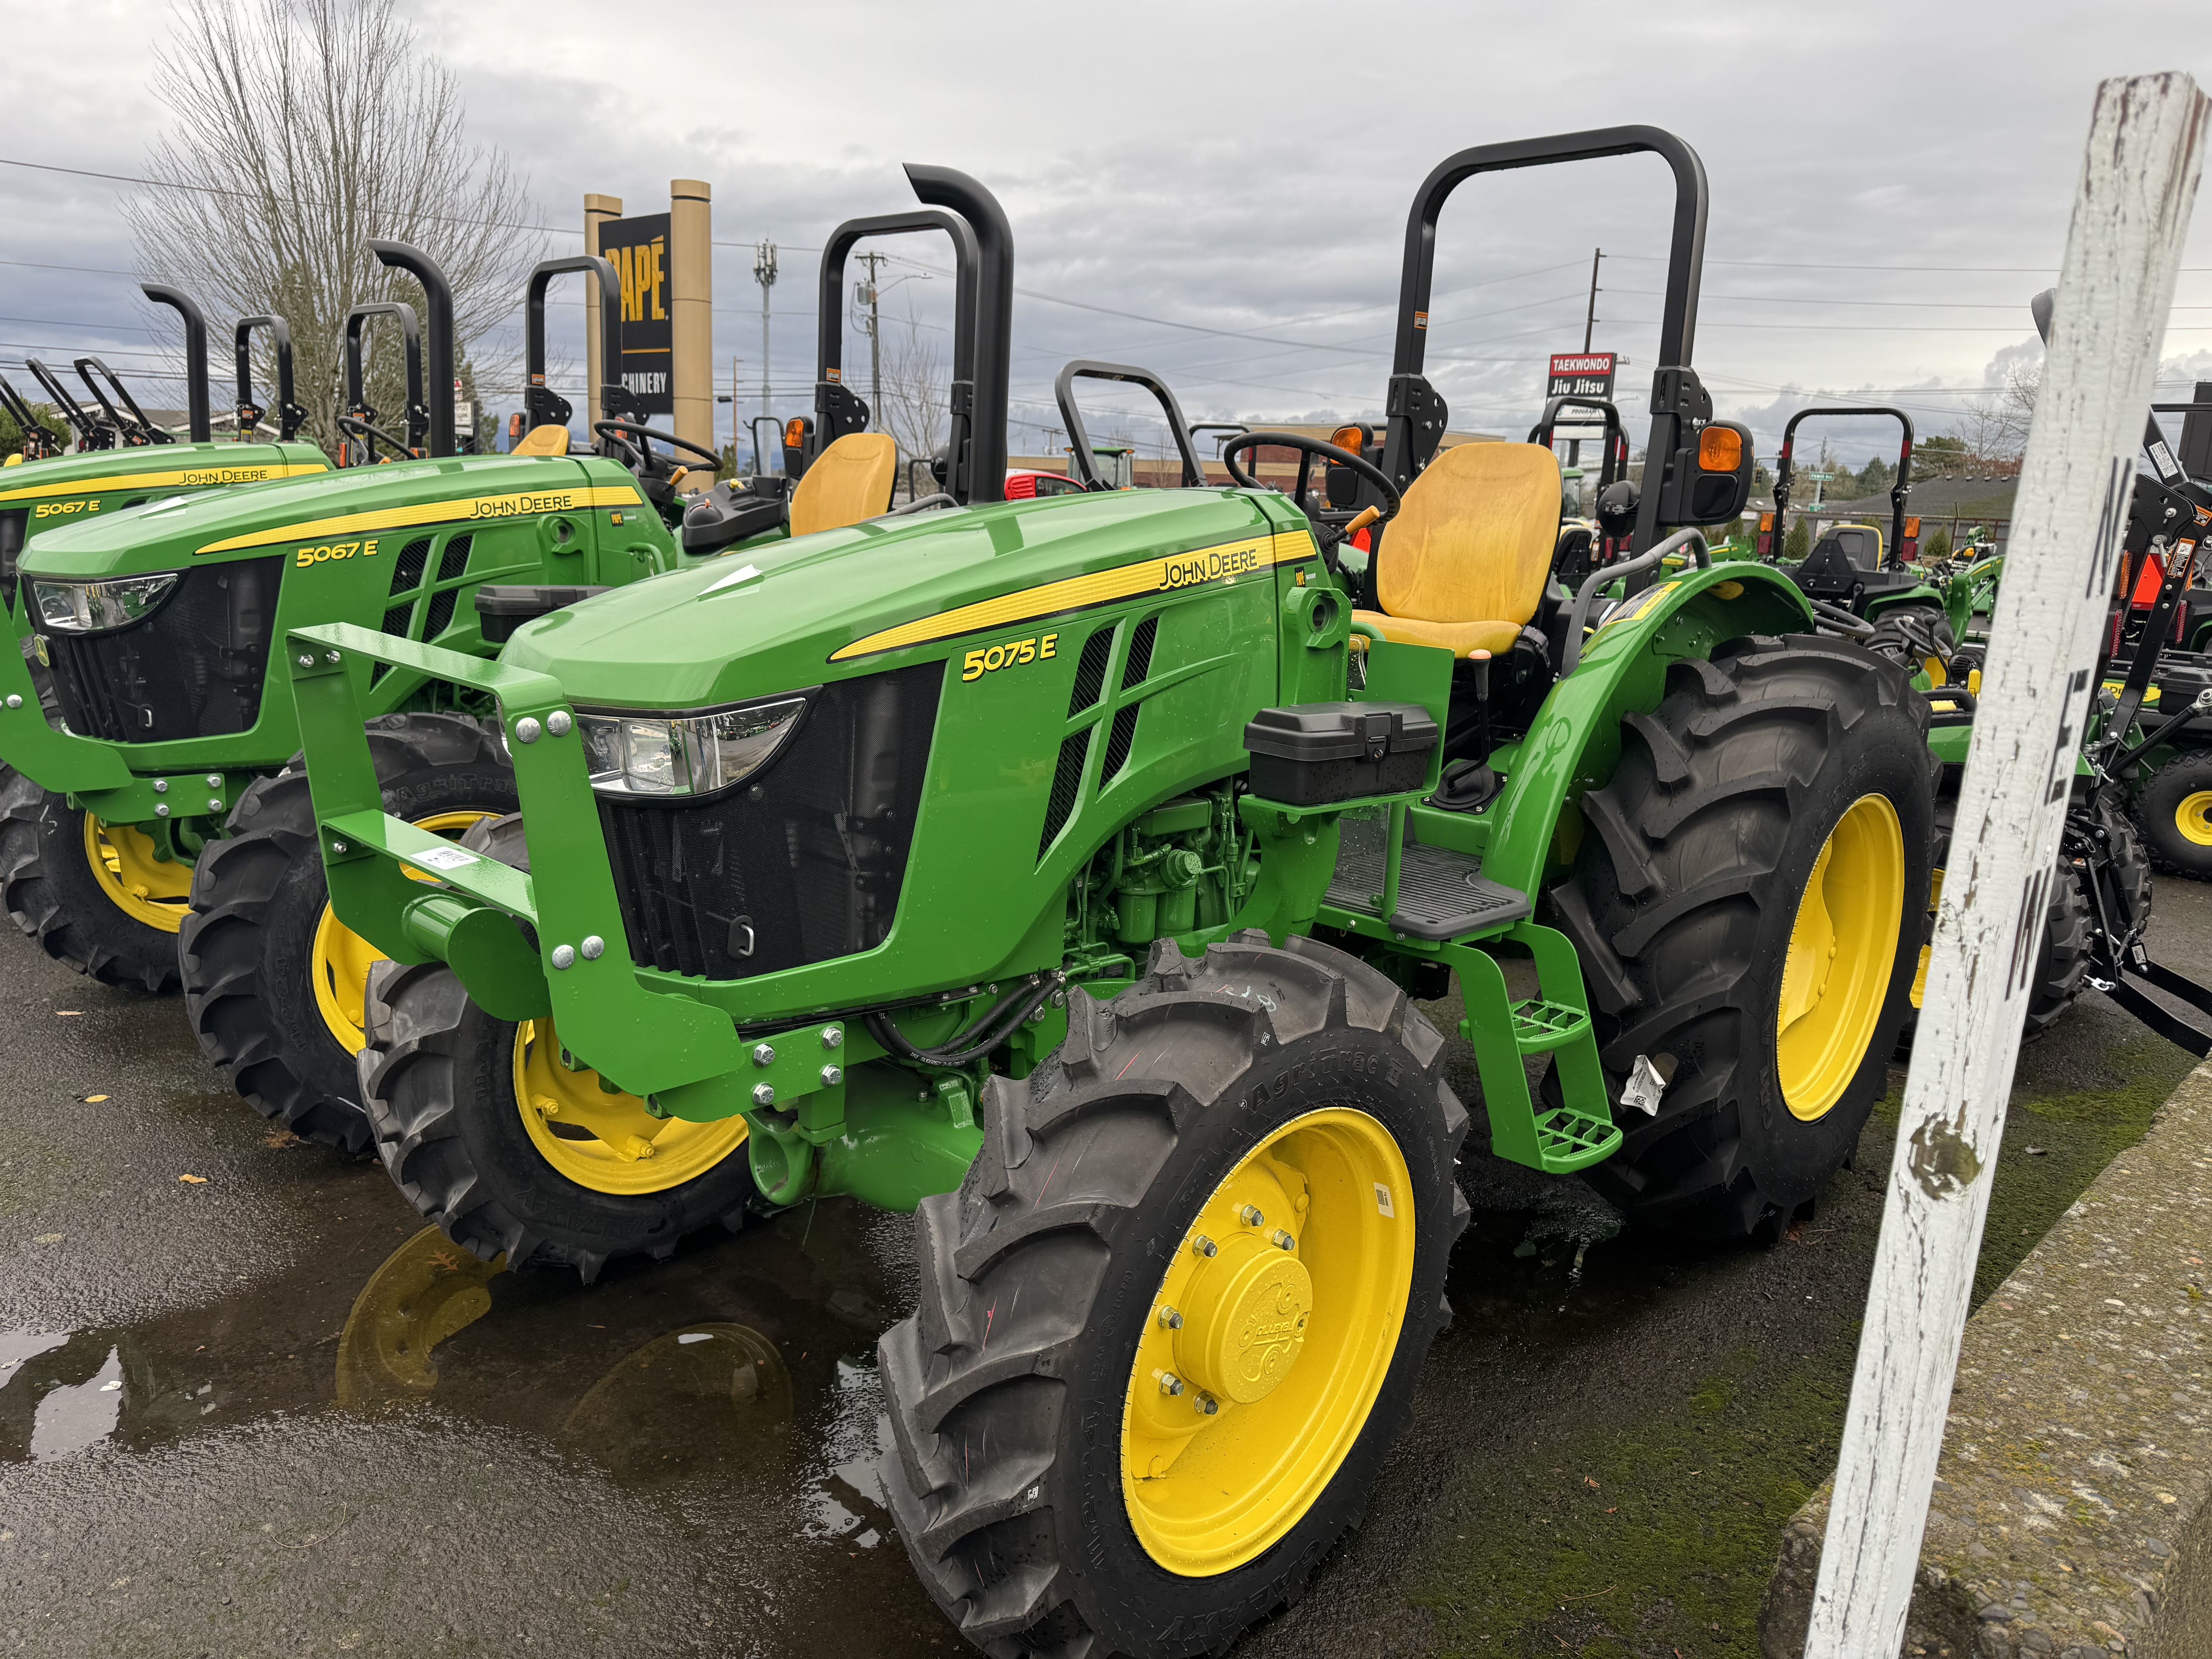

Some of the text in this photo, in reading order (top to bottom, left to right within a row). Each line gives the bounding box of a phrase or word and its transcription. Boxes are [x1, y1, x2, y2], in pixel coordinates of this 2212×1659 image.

[1553, 357, 1609, 372] TAEKWONDO
[621, 372, 667, 393] CHINERY
[1551, 378, 1604, 394] Jiu Jitsu
[179, 469, 268, 486] JOHN DEERE
[35, 501, 86, 518] 5067
[469, 495, 574, 520] JOHN DEERE
[296, 541, 360, 568] 5067
[1158, 548, 1259, 591] JOHN DEERE
[962, 636, 1037, 683] 5075
[1250, 1049, 1379, 1115] AgriTrac
